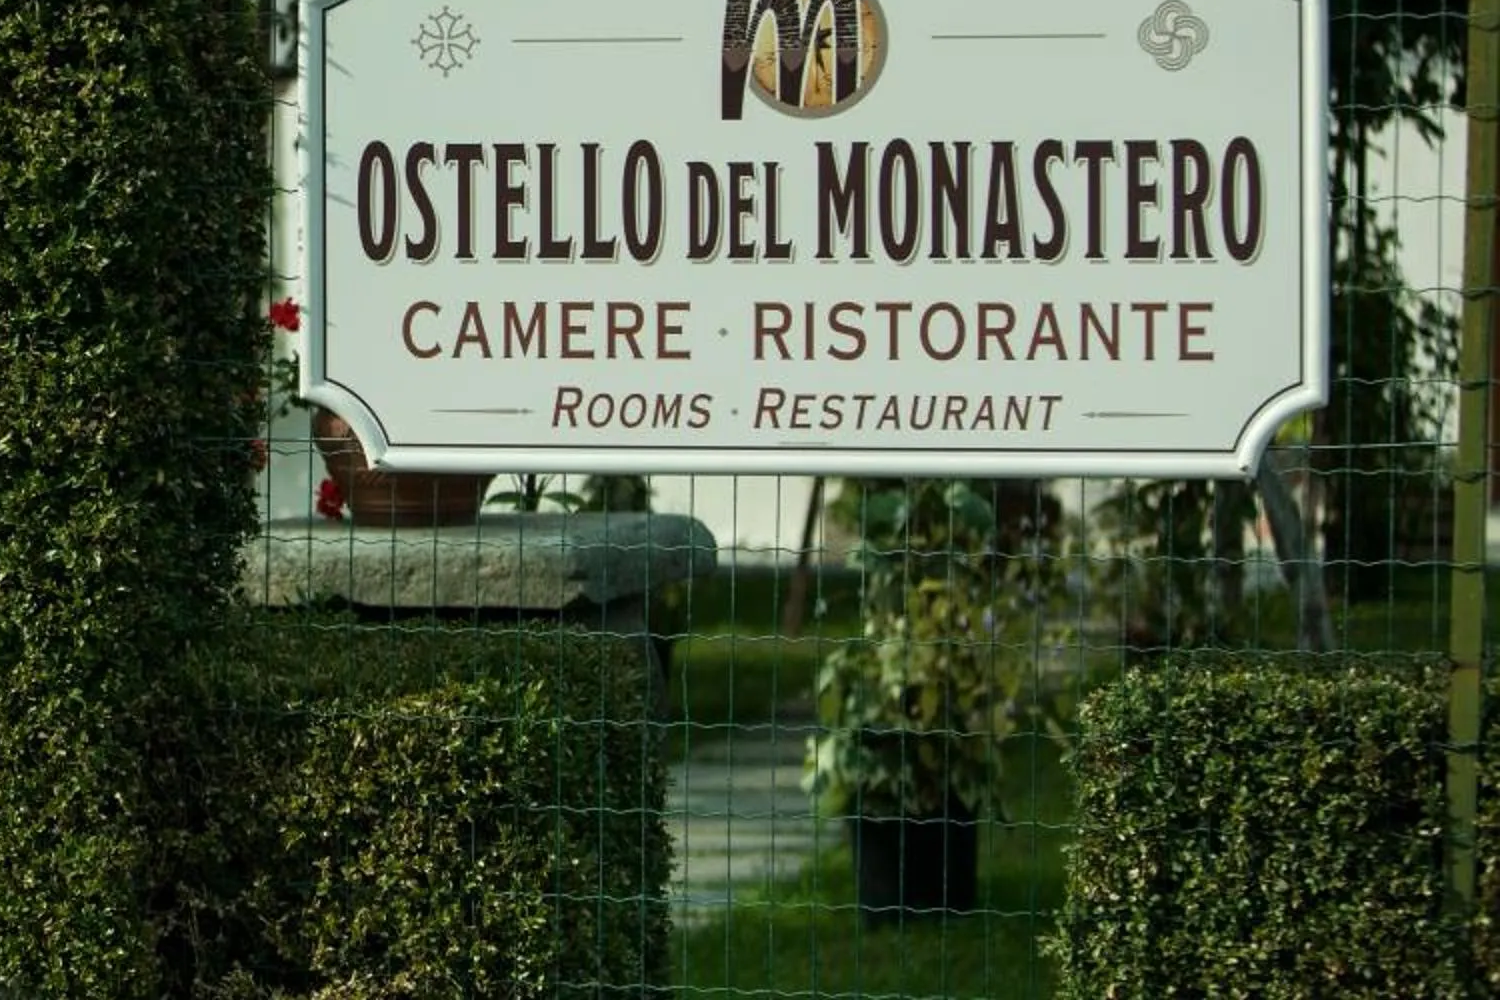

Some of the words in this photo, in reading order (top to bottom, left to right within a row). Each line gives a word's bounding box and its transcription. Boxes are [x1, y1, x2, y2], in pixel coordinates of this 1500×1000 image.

[357, 139, 665, 265] OSTELLO
[685, 161, 795, 264] DEL
[814, 135, 1267, 266] MONASTERO
[402, 300, 692, 360] CAMERE
[753, 301, 1215, 362] RISTORANTE
[552, 386, 714, 430] ROOMS
[753, 387, 1064, 431] RESTAURANT
